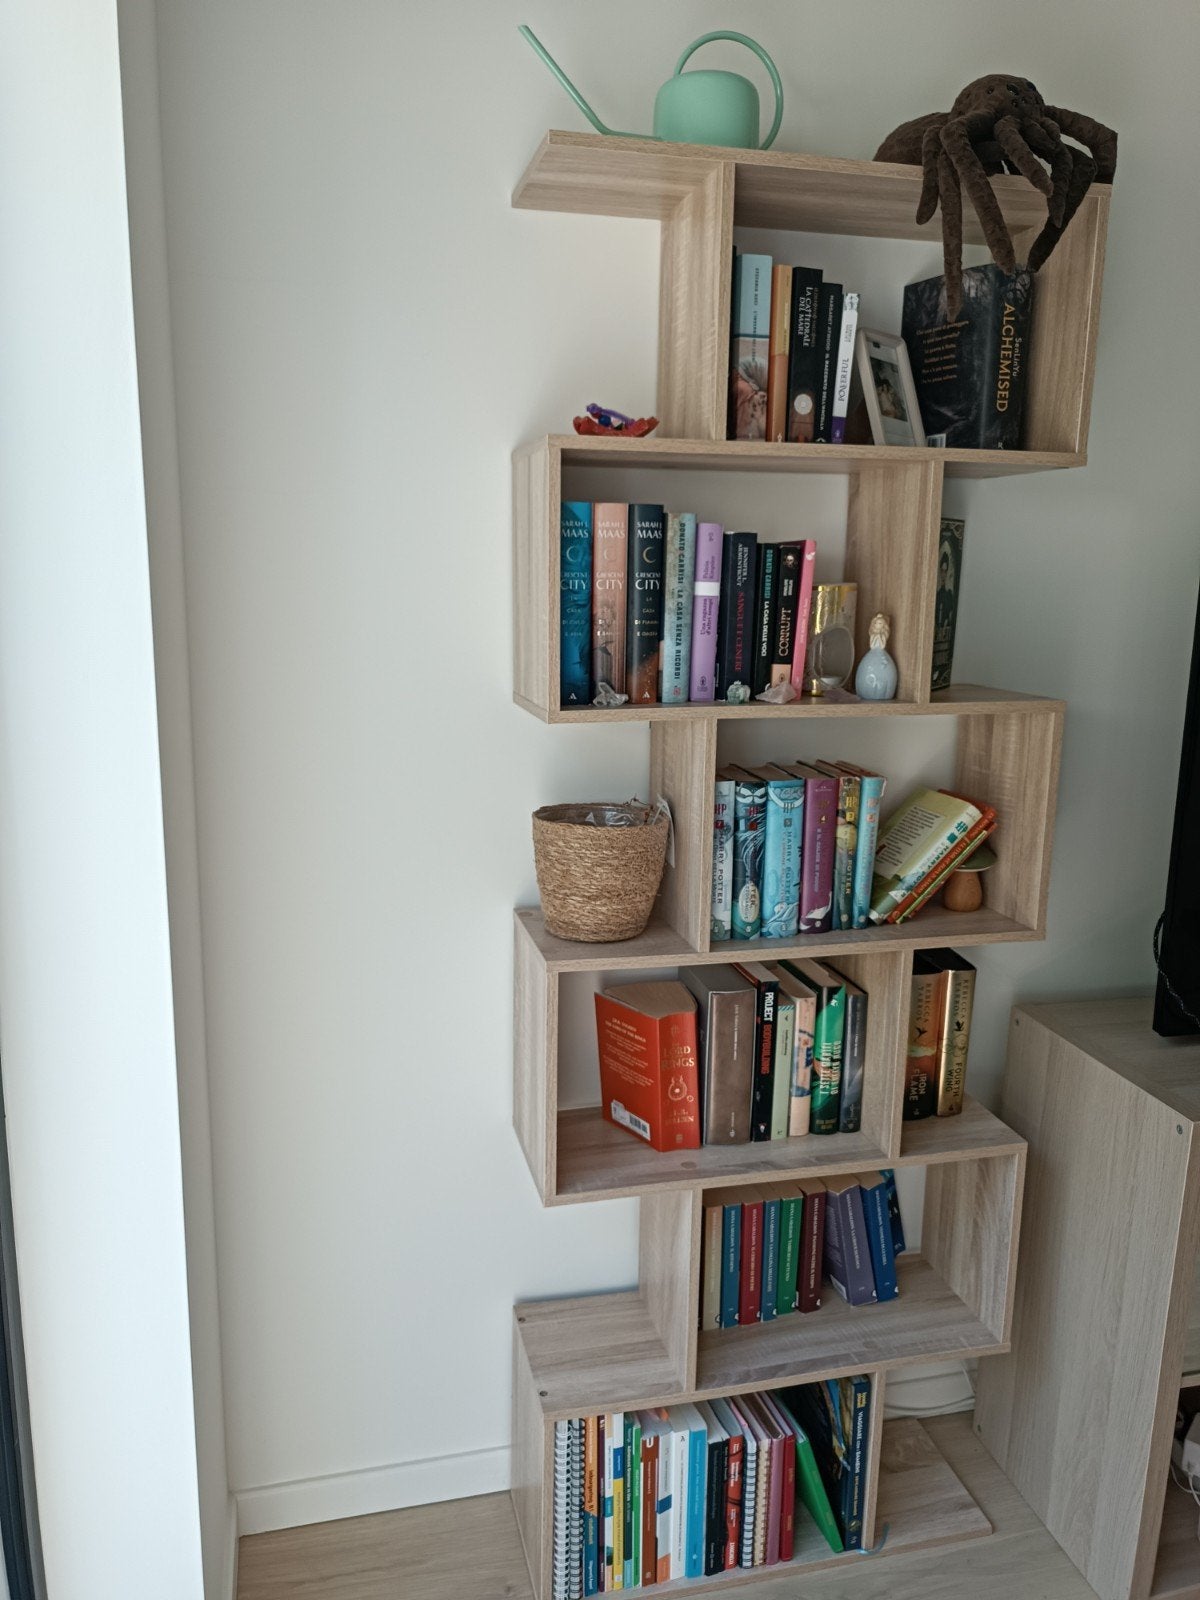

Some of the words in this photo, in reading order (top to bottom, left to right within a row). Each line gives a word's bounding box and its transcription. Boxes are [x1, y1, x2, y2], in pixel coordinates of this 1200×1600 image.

[804, 286, 812, 296] LA
[802, 297, 812, 346] CATTEDRALE
[997, 302, 1015, 414] ALCHEMISED
[1012, 337, 1022, 377] SenLinYu
[838, 357, 850, 402] POWERFUL
[819, 391, 827, 430] DELL'ANCELLA
[562, 529, 589, 538] MAAS
[598, 530, 626, 538] MAAS
[637, 530, 663, 538] MAAS
[560, 580, 587, 590] CITY
[596, 580, 624, 590] CITY
[635, 580, 660, 590] CITY
[676, 589, 683, 598] LA
[736, 591, 745, 628] SANGUE
[764, 600, 769, 608] LA
[778, 607, 792, 656] CORRUPT
[734, 636, 743, 672] CENERE
[925, 843, 949, 870] HARRY
[763, 992, 774, 1021] PROJECT
[760, 1023, 772, 1074] BODYBUILDING
[908, 1068, 921, 1102] FLAME
[917, 1072, 928, 1095] IRON
[944, 1068, 954, 1092] WING
[951, 1061, 962, 1097] FOURTH
